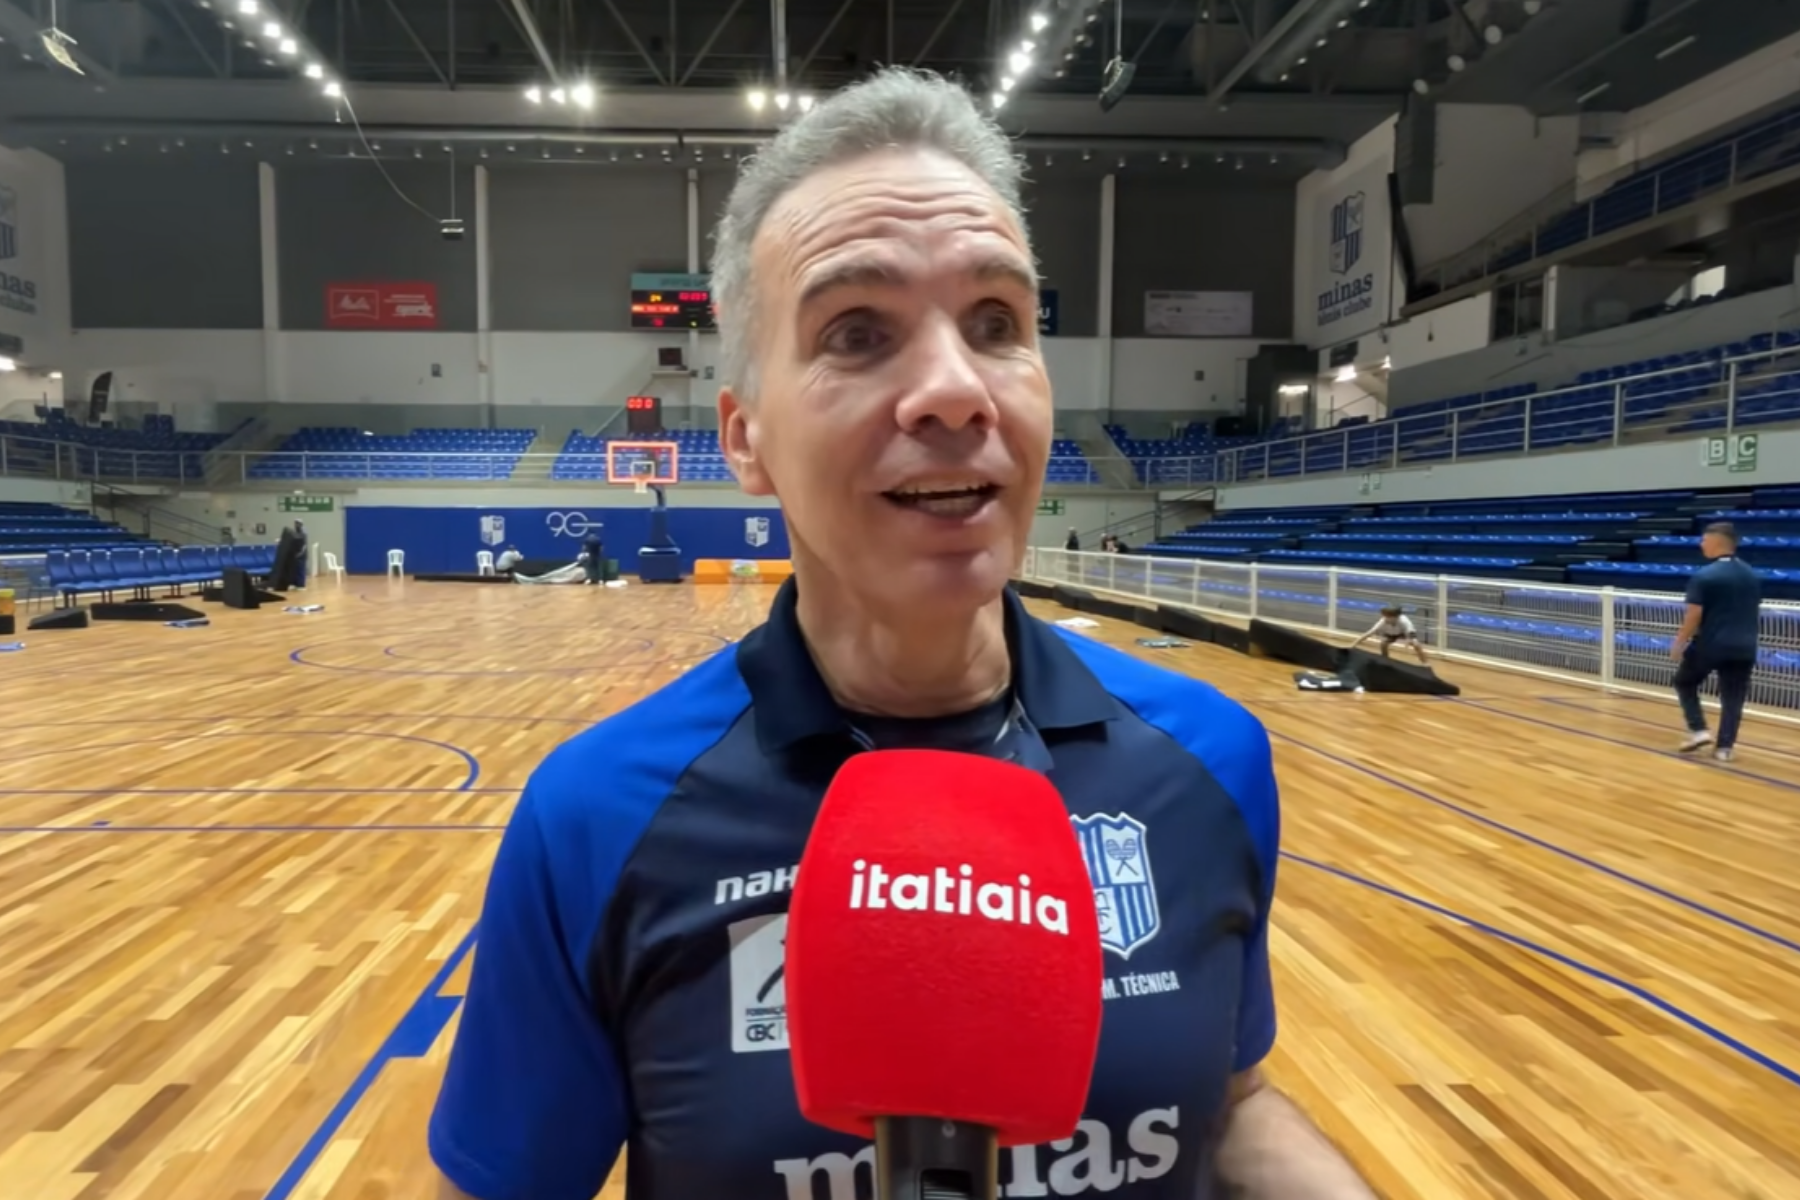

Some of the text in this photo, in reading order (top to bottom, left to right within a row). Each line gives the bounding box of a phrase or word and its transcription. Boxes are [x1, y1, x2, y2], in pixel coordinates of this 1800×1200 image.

[1318, 273, 1373, 311] minas
[1710, 440, 1725, 458] B
[1740, 436, 1756, 456] C
[850, 859, 1069, 935] itatiaia
[1119, 971, 1181, 997] TÉCNICA
